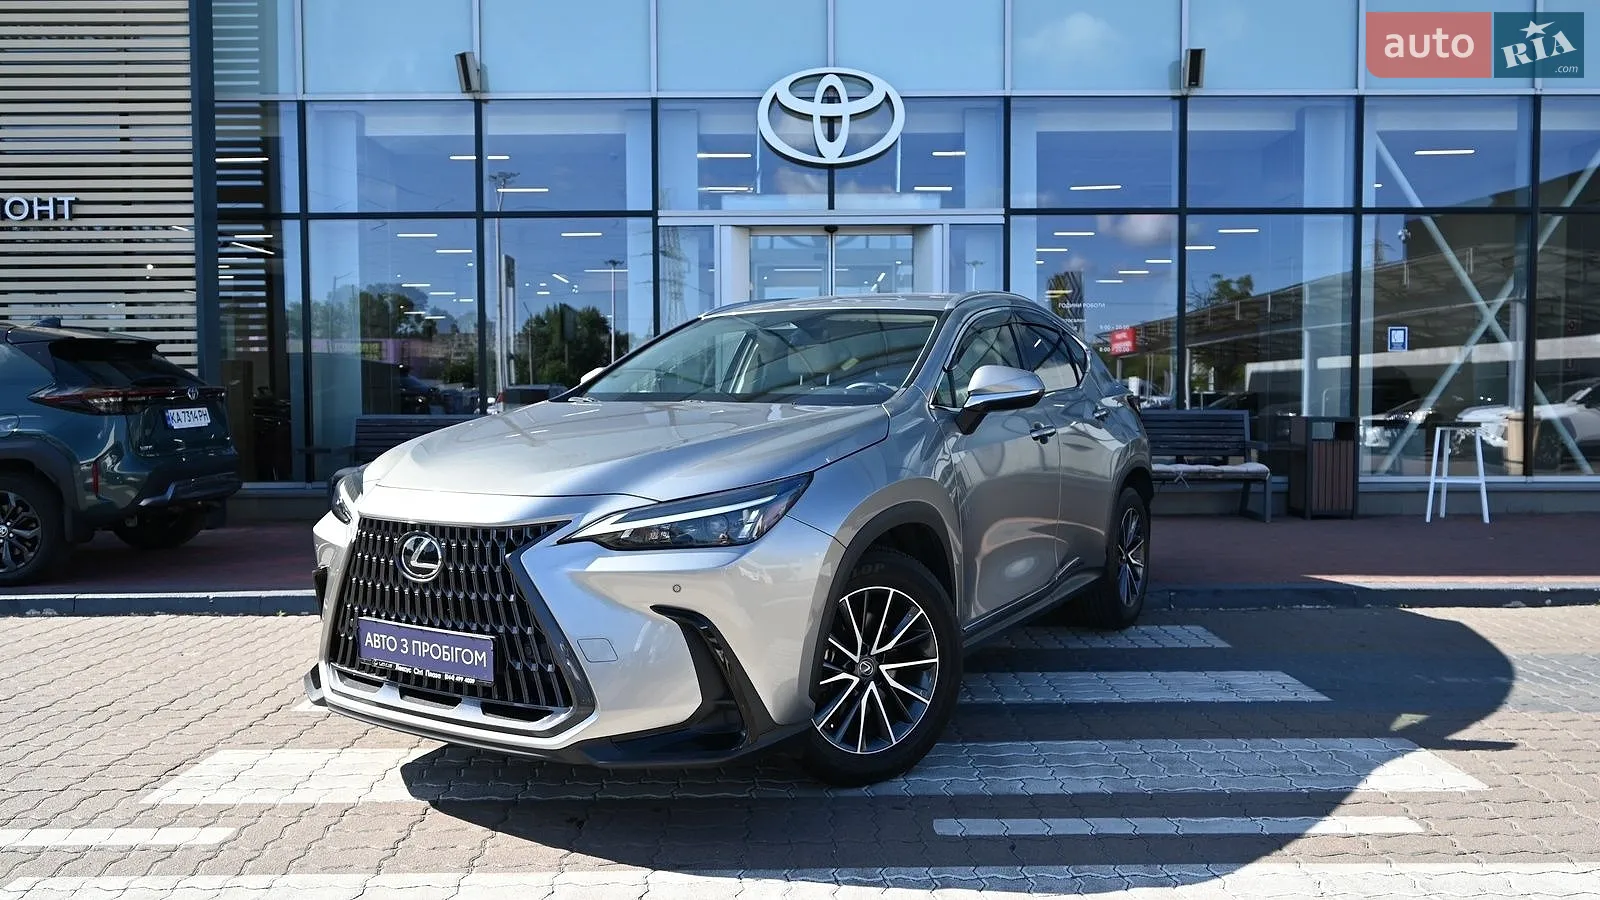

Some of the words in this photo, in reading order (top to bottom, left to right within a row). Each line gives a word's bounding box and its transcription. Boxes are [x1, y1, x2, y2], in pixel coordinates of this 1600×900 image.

[182, 410, 198, 423] 7314
[364, 631, 397, 652] АВТО
[412, 640, 487, 667] ПРОБІГОМ
